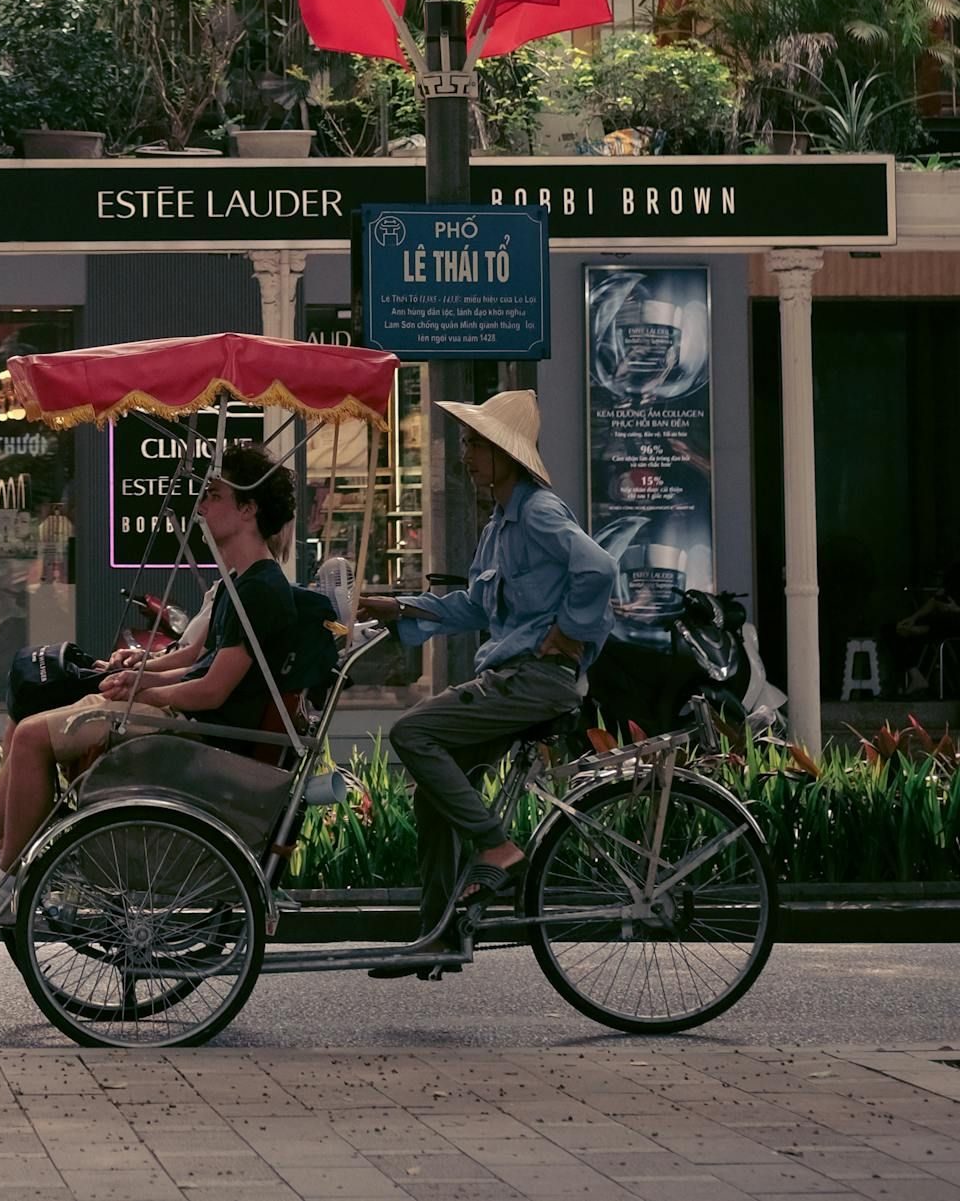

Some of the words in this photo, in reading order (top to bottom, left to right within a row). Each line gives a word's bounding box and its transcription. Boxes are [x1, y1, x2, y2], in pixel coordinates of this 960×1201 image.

[207, 189, 343, 218] LAUDER
[623, 186, 735, 216] BROWN
[434, 214, 479, 239] PHỐ
[403, 243, 427, 283] LÊ
[433, 244, 479, 283] THÁI
[484, 234, 511, 283] TỔ
[640, 444, 664, 455] 96%
[641, 475, 664, 486] 15%
